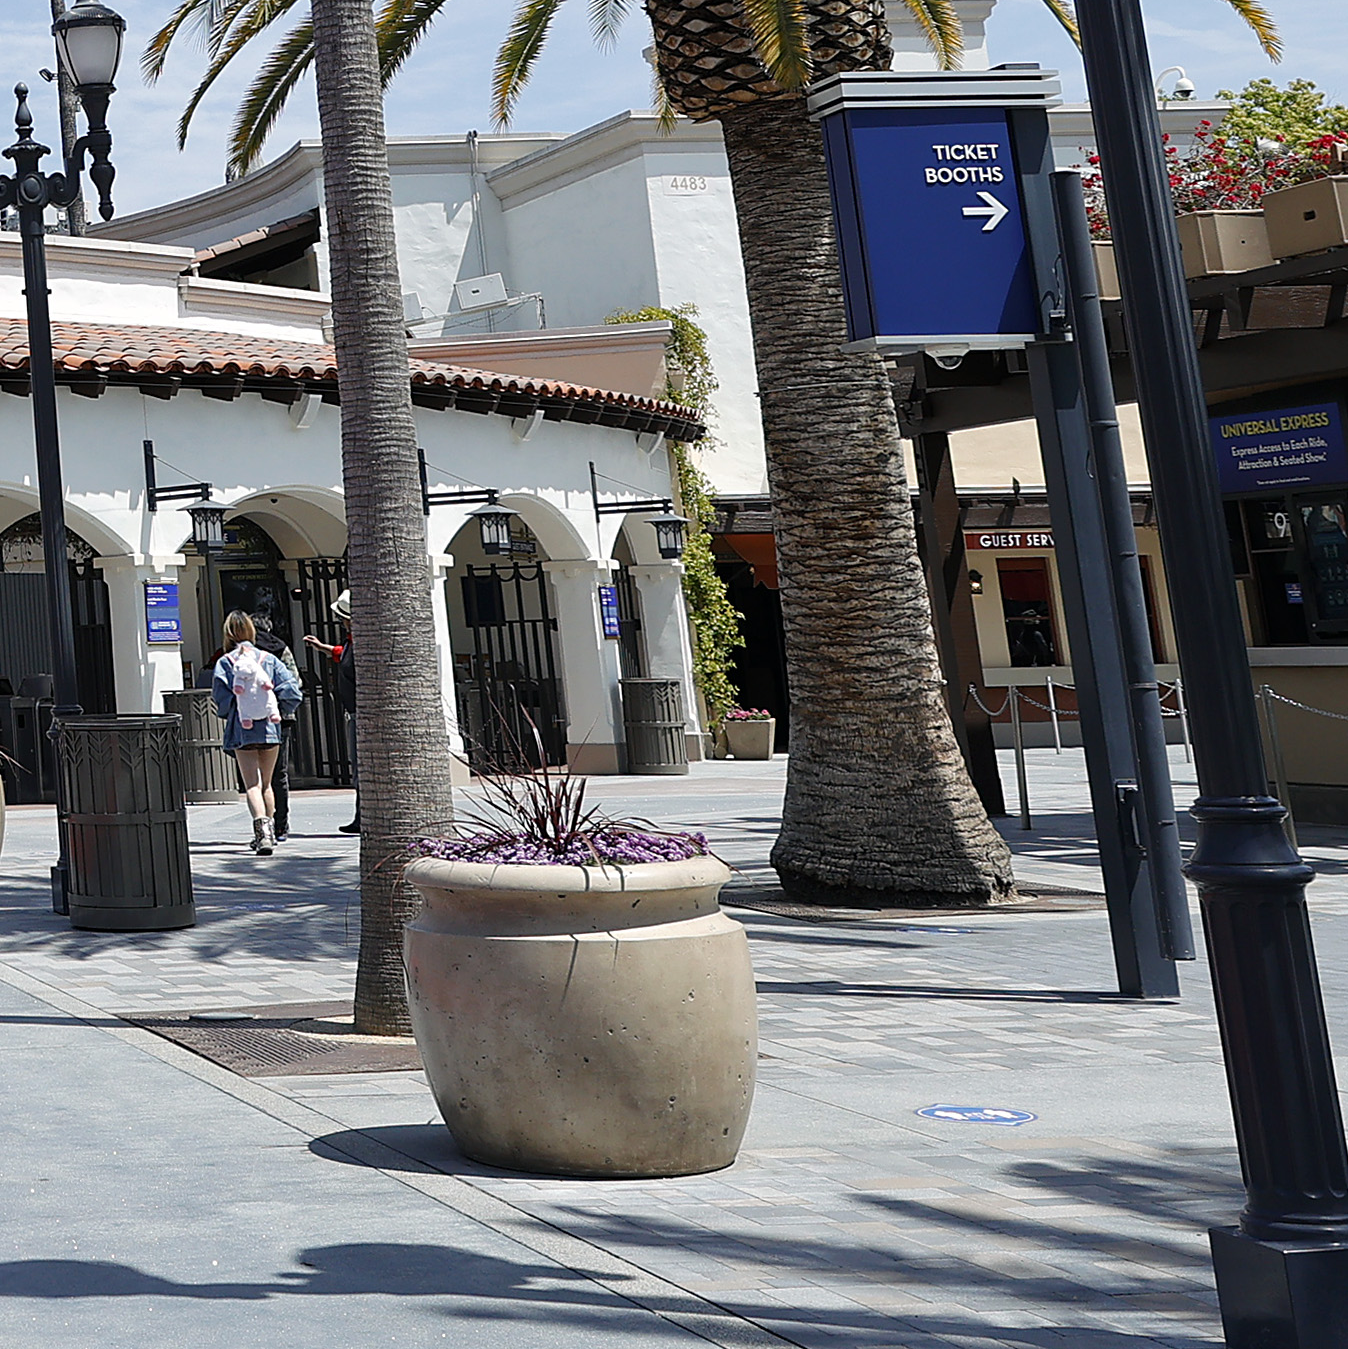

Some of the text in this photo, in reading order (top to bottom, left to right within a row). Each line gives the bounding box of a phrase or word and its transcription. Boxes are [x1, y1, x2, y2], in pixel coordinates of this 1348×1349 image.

[932, 144, 999, 160] TICKET
[925, 166, 1004, 183] BOOTHS
[670, 176, 707, 191] 4483
[1220, 412, 1330, 439] UNIVERSAL EXPRESS
[1231, 446, 1258, 458] Express
[1258, 443, 1282, 454] Access
[1281, 441, 1290, 451] to
[1290, 438, 1309, 450] Each
[1238, 457, 1273, 471] Attraction
[1272, 456, 1279, 467] &
[1279, 453, 1305, 466] Seated
[1274, 512, 1286, 538] 9
[979, 534, 1022, 547] GUEST
